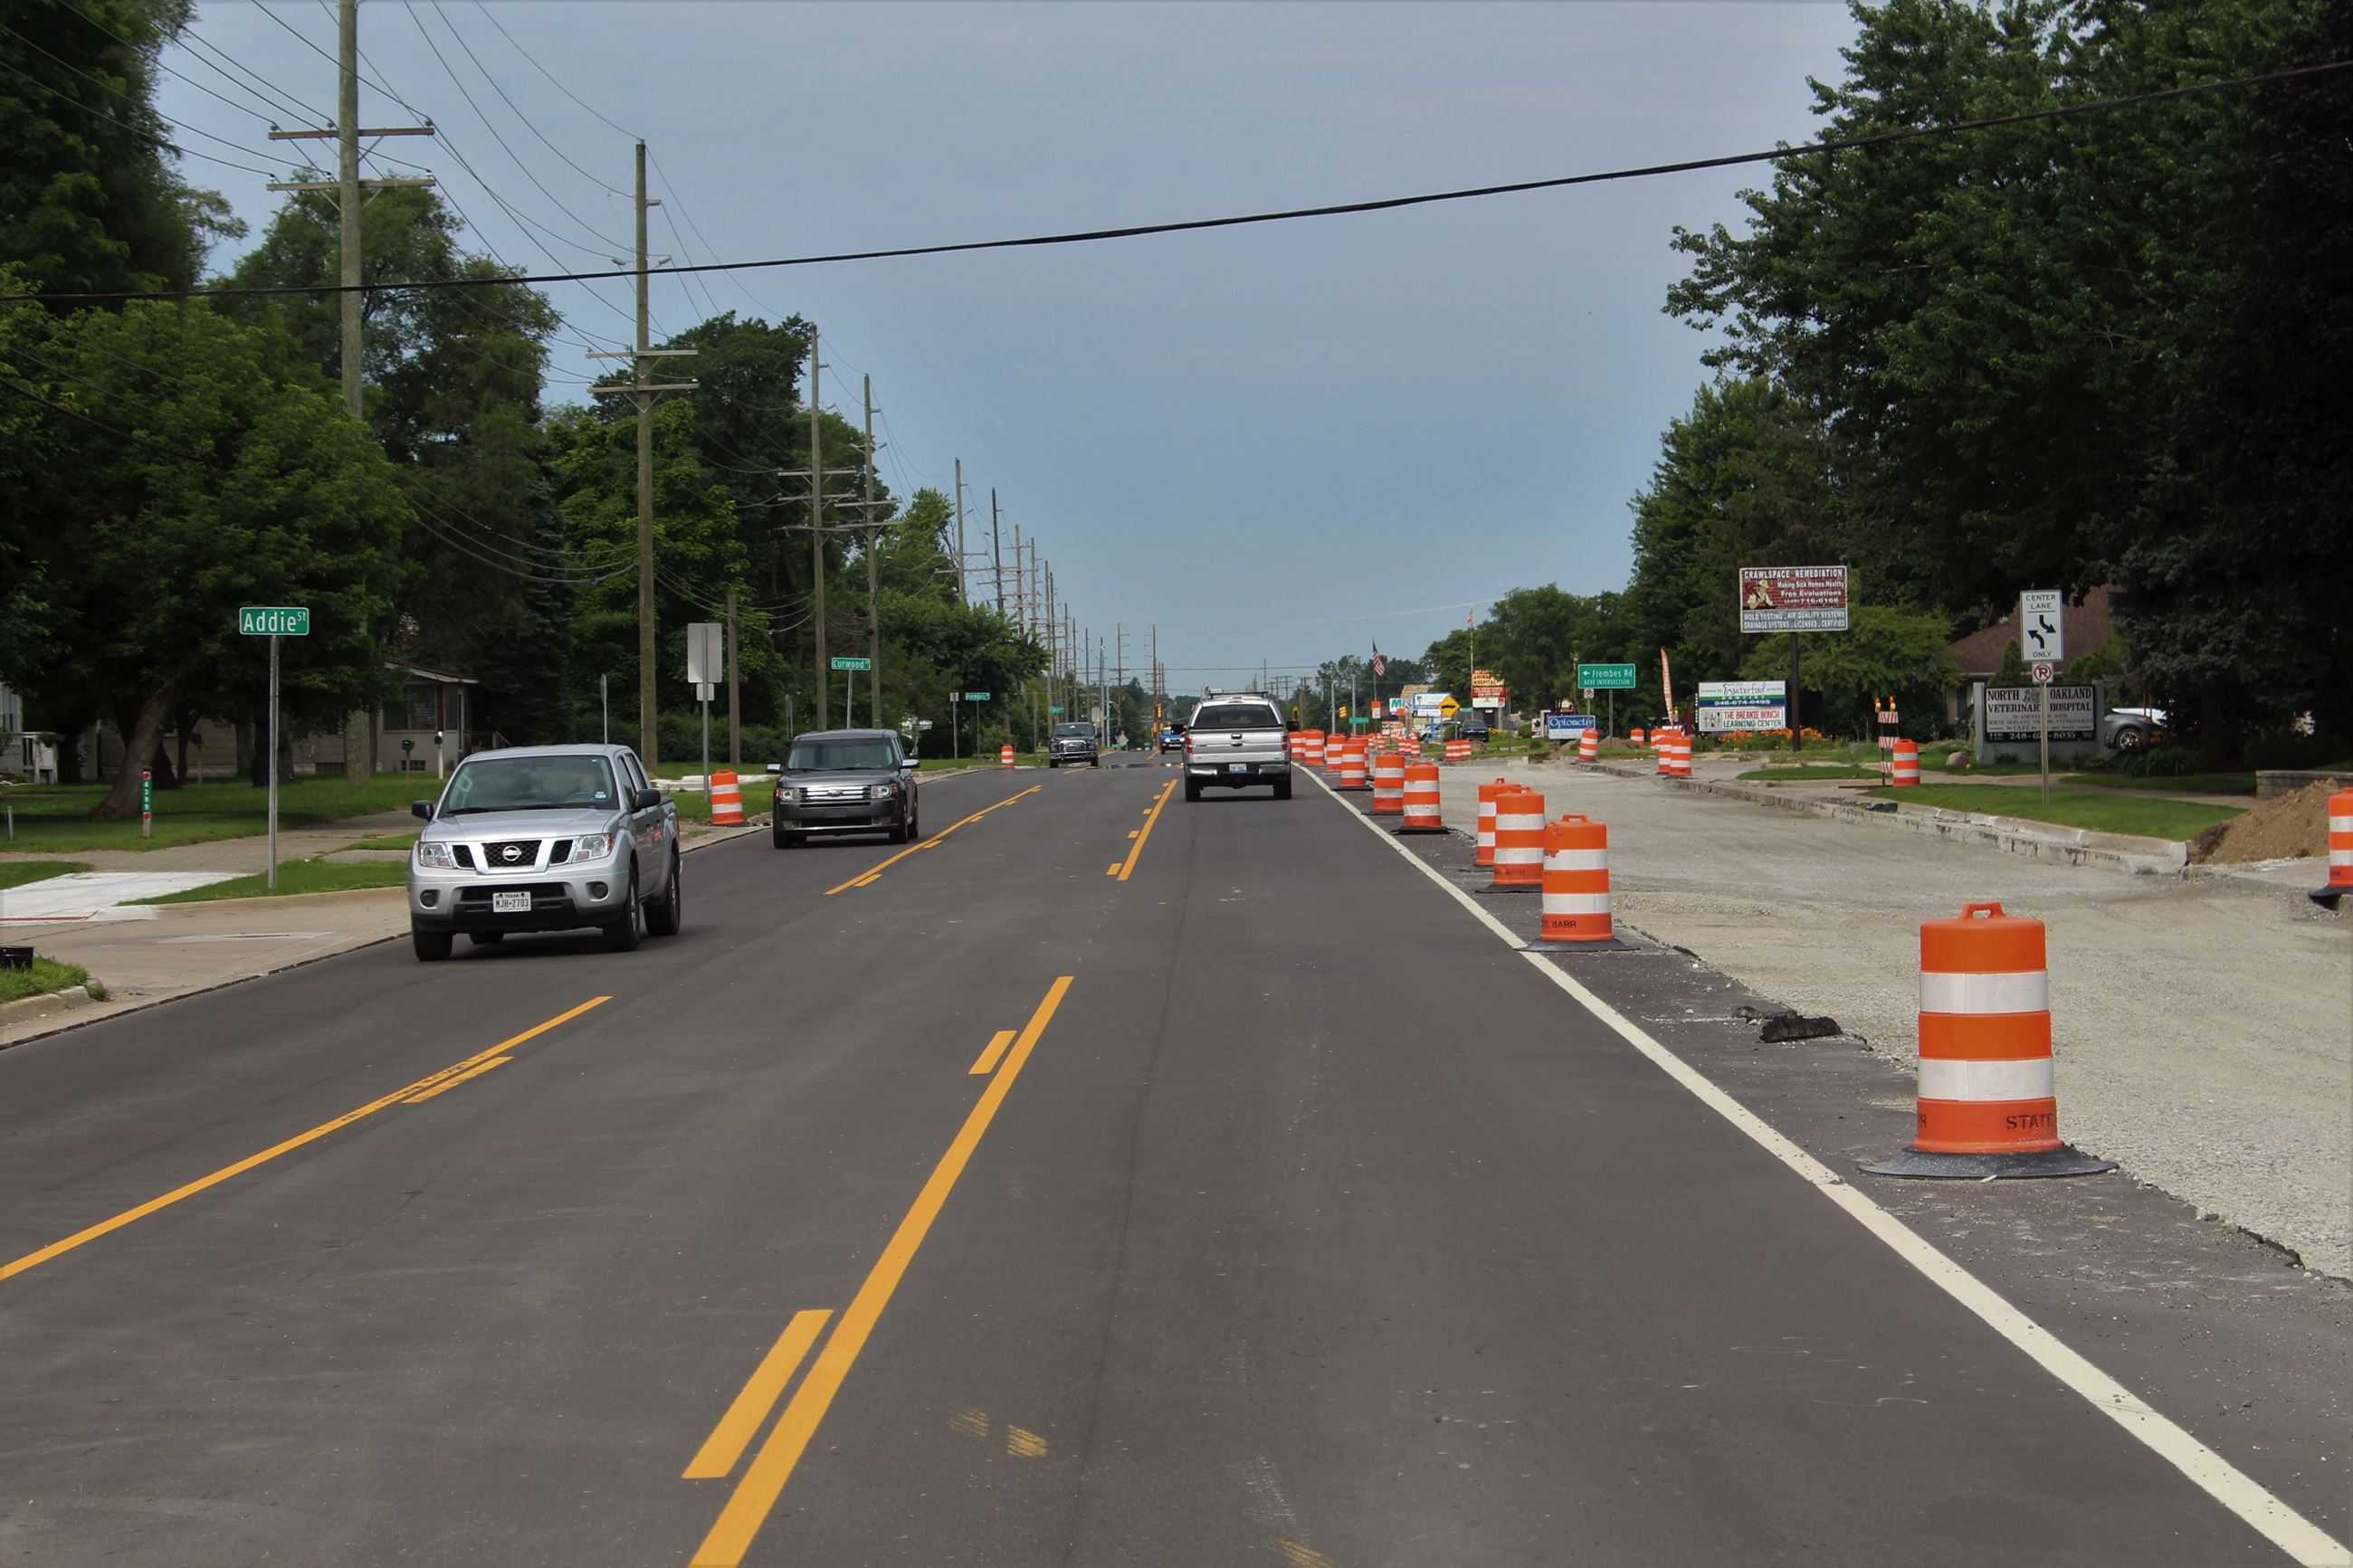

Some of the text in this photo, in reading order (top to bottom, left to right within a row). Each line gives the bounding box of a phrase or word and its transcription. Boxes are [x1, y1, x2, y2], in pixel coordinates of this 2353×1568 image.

[1744, 569, 1843, 579] CRAWLSPACE REMEDIATION
[1777, 581, 1796, 590] Making
[2025, 594, 2056, 602] CENTER
[243, 611, 307, 632] Addie St
[1760, 613, 1783, 621] TESTING
[1744, 622, 1767, 630] DRAINAGE
[1768, 621, 1789, 629] SYSTEMS
[1794, 620, 1817, 628] LICENSED
[834, 660, 864, 669] Curwood
[1592, 669, 1633, 678] Frembes Rd
[1987, 689, 2091, 701] NORTH OAKLAND
[2050, 702, 2092, 712] HOSPITAL
[1723, 711, 1735, 719] THE
[1760, 710, 1780, 719] BUNCH
[1723, 719, 1781, 728] LEARNING CENTER
